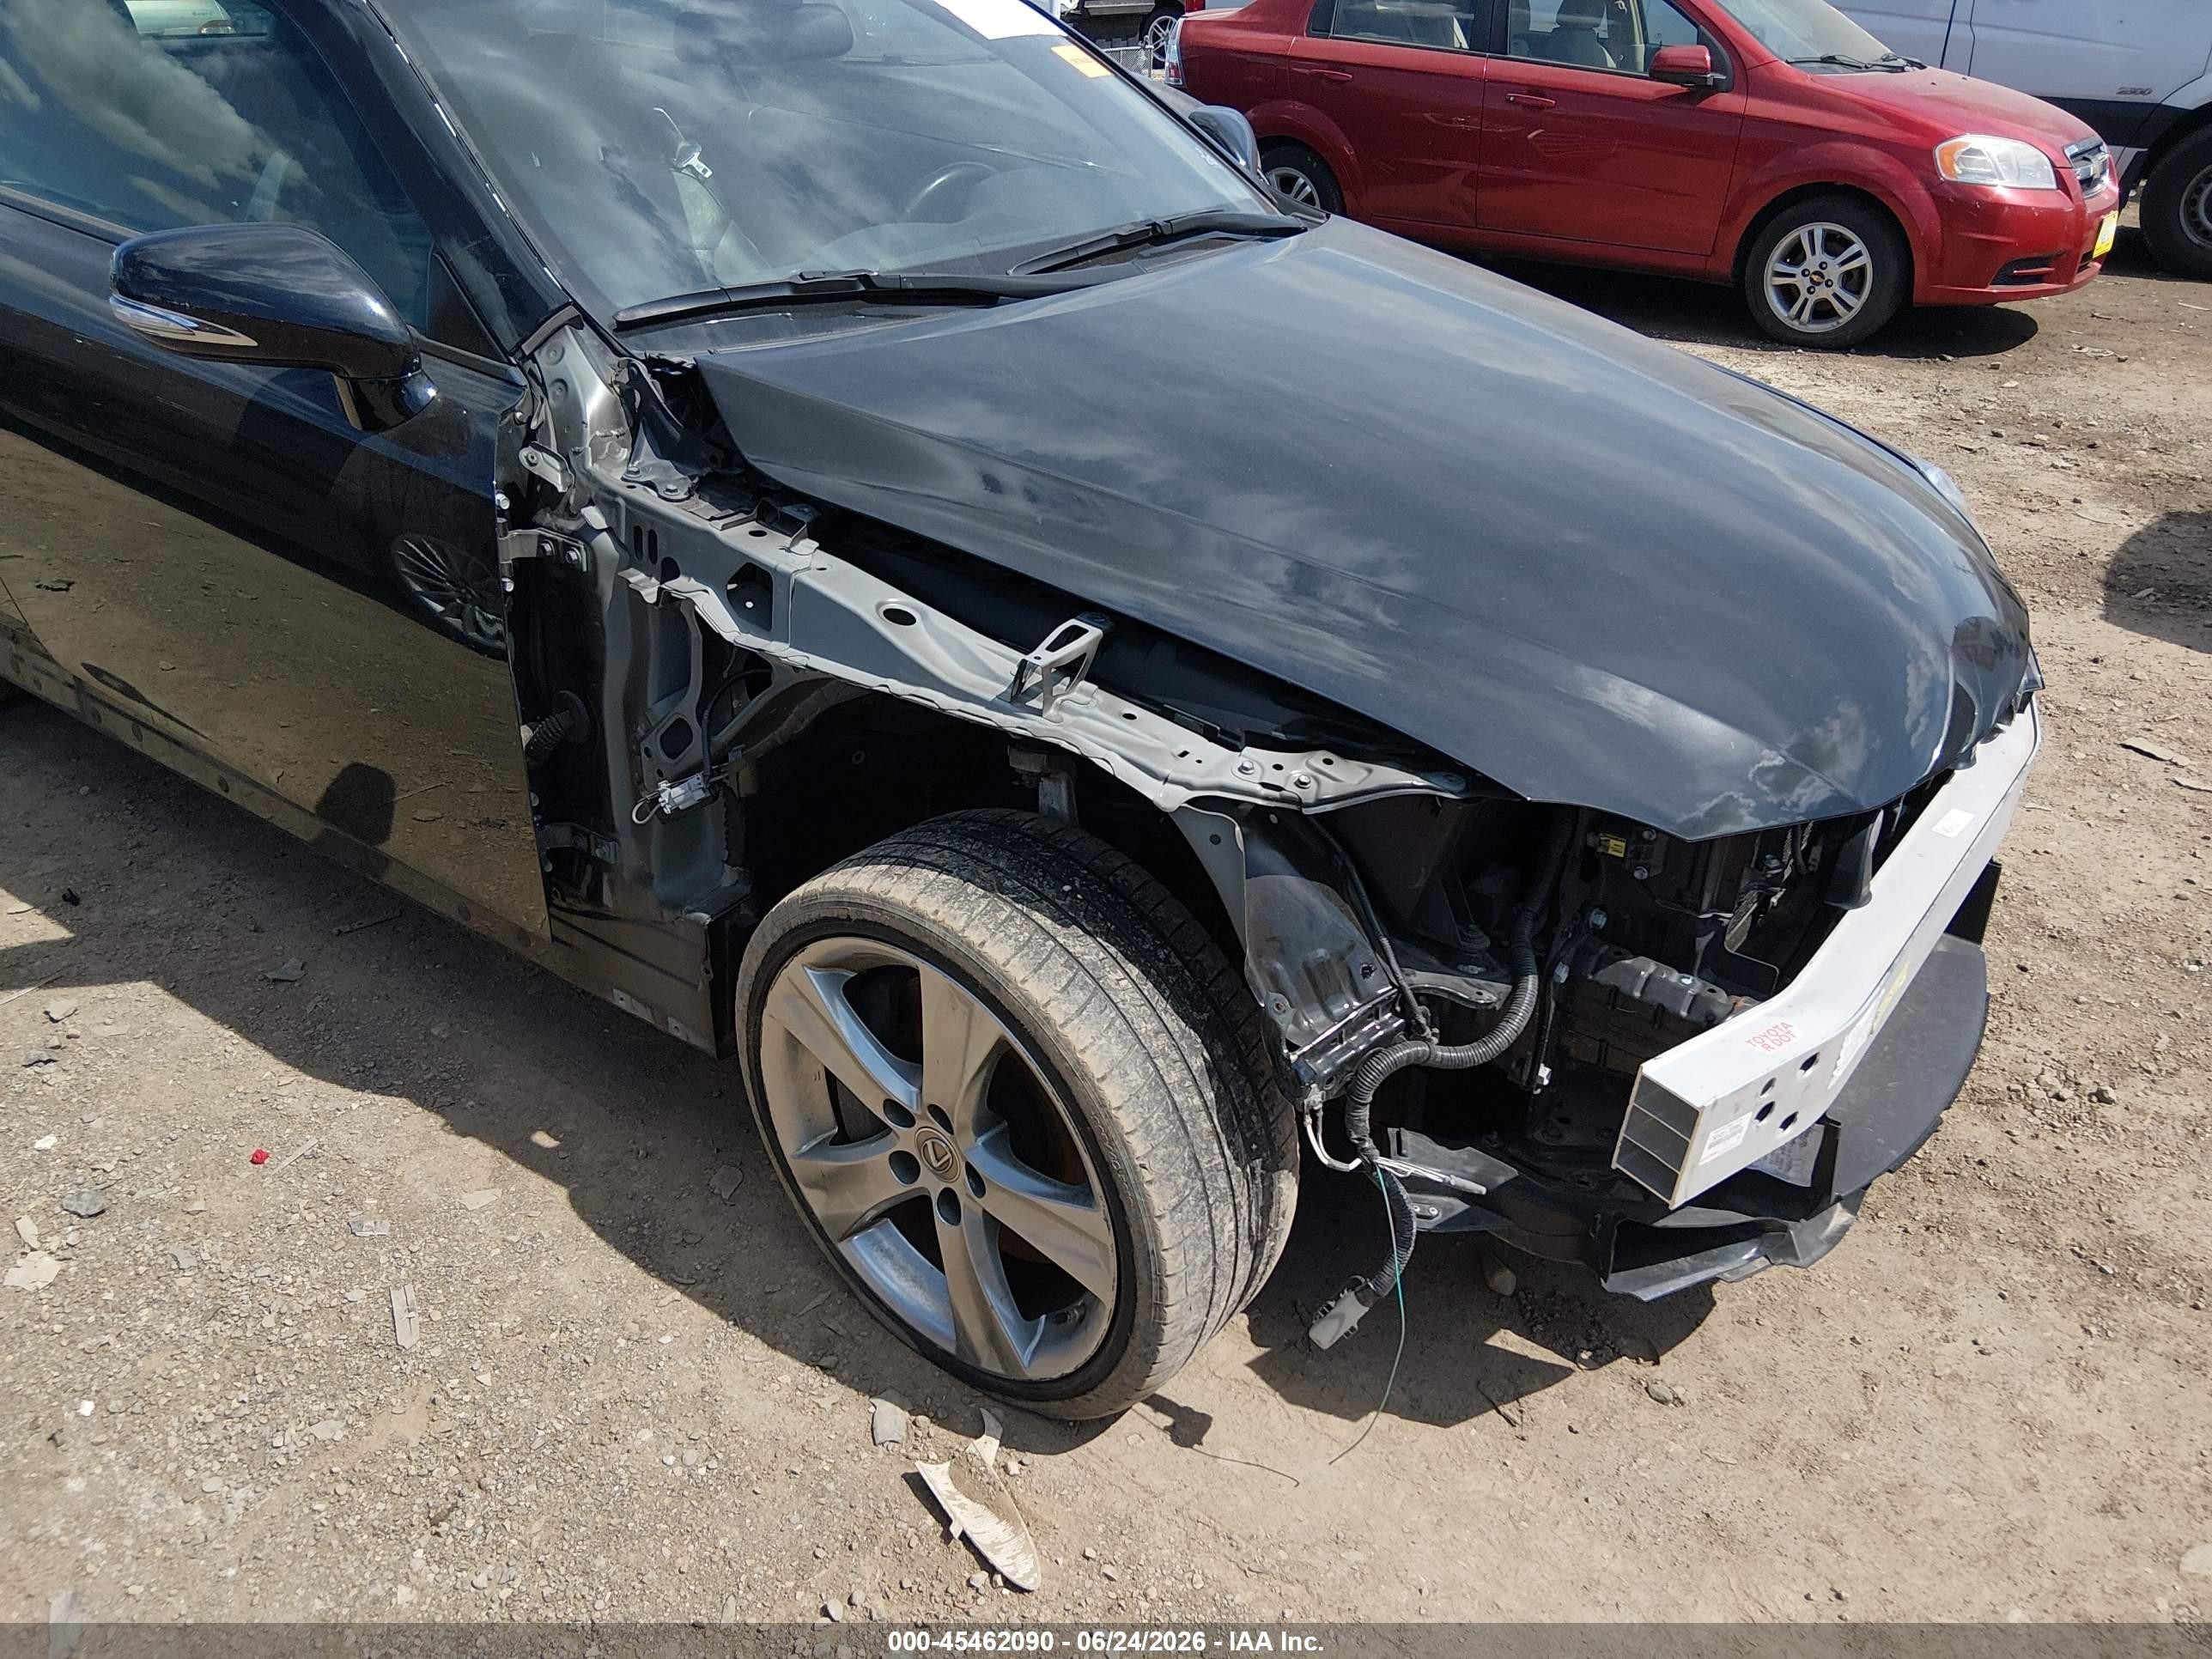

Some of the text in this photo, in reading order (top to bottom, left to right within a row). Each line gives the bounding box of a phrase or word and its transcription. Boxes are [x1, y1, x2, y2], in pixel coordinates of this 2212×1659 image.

[1745, 1022, 1794, 1047] TOYOTA
[1760, 1030, 1798, 1052] R DOT
